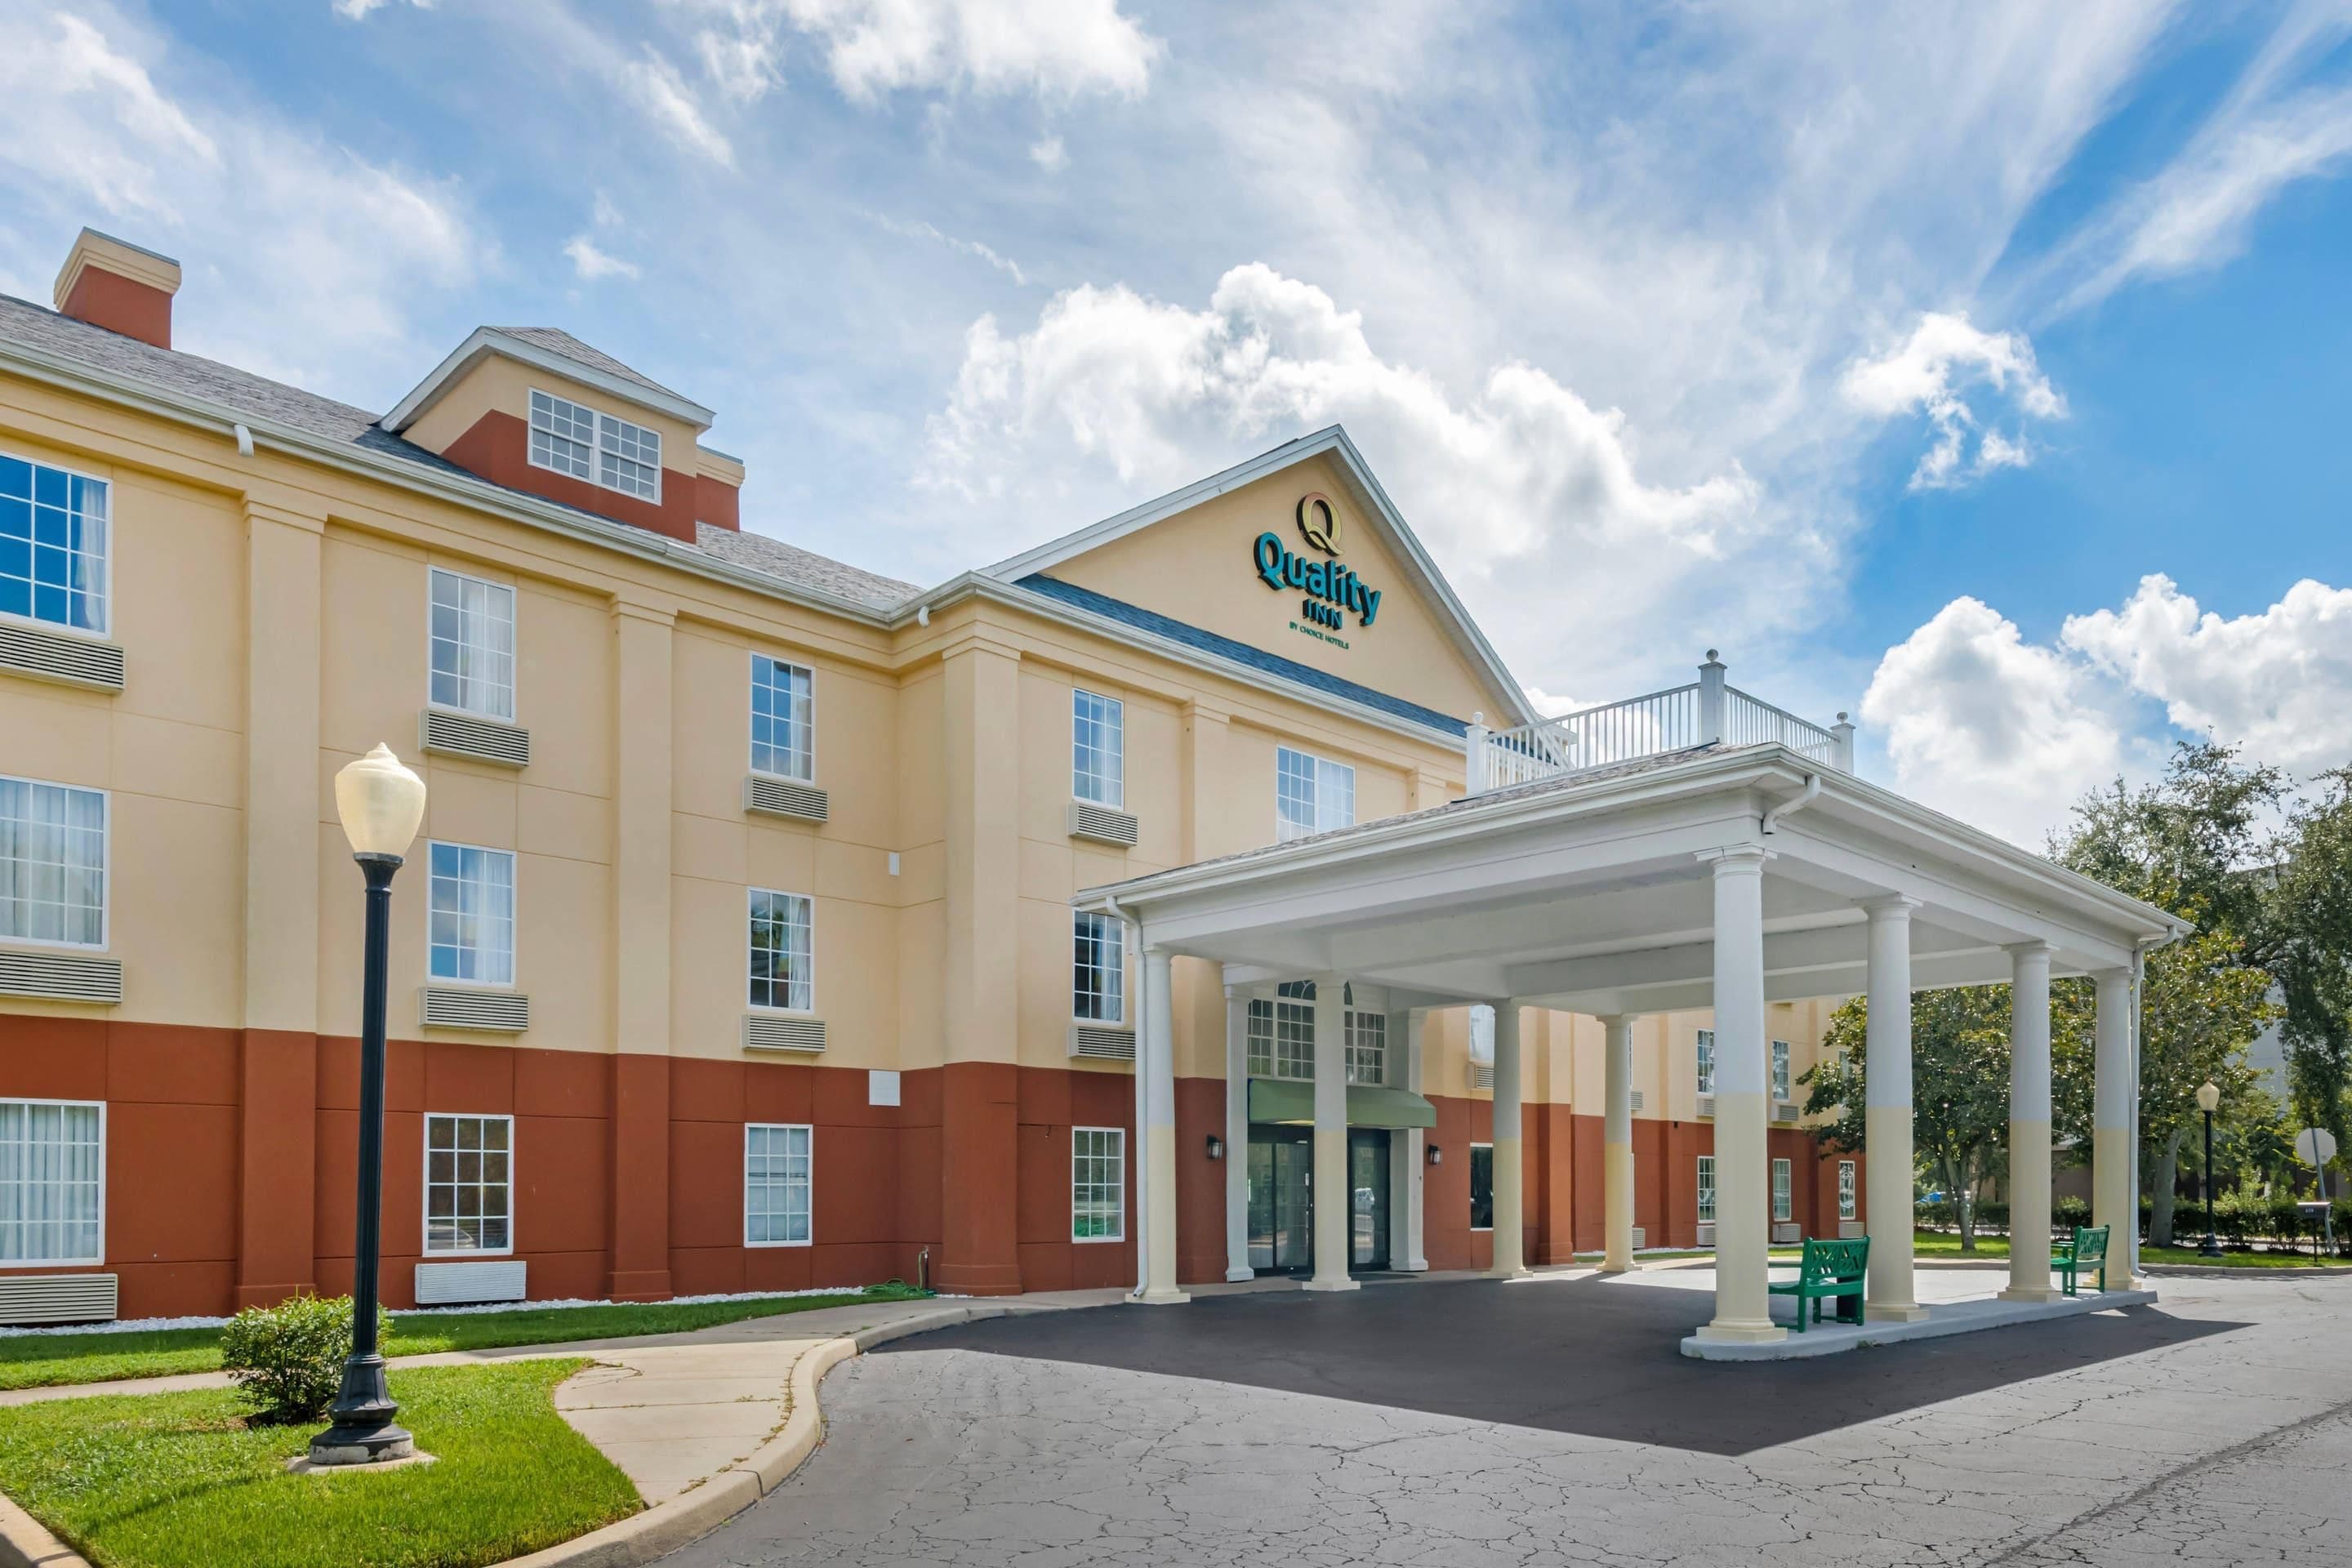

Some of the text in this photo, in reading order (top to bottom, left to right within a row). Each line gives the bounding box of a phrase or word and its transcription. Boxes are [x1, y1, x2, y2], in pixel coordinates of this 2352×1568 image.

[1296, 492, 1344, 557] Q
[1254, 532, 1381, 627] Quality
[1290, 621, 1349, 650] BY CHOICE HOTELS
[1303, 599, 1343, 630] INN
